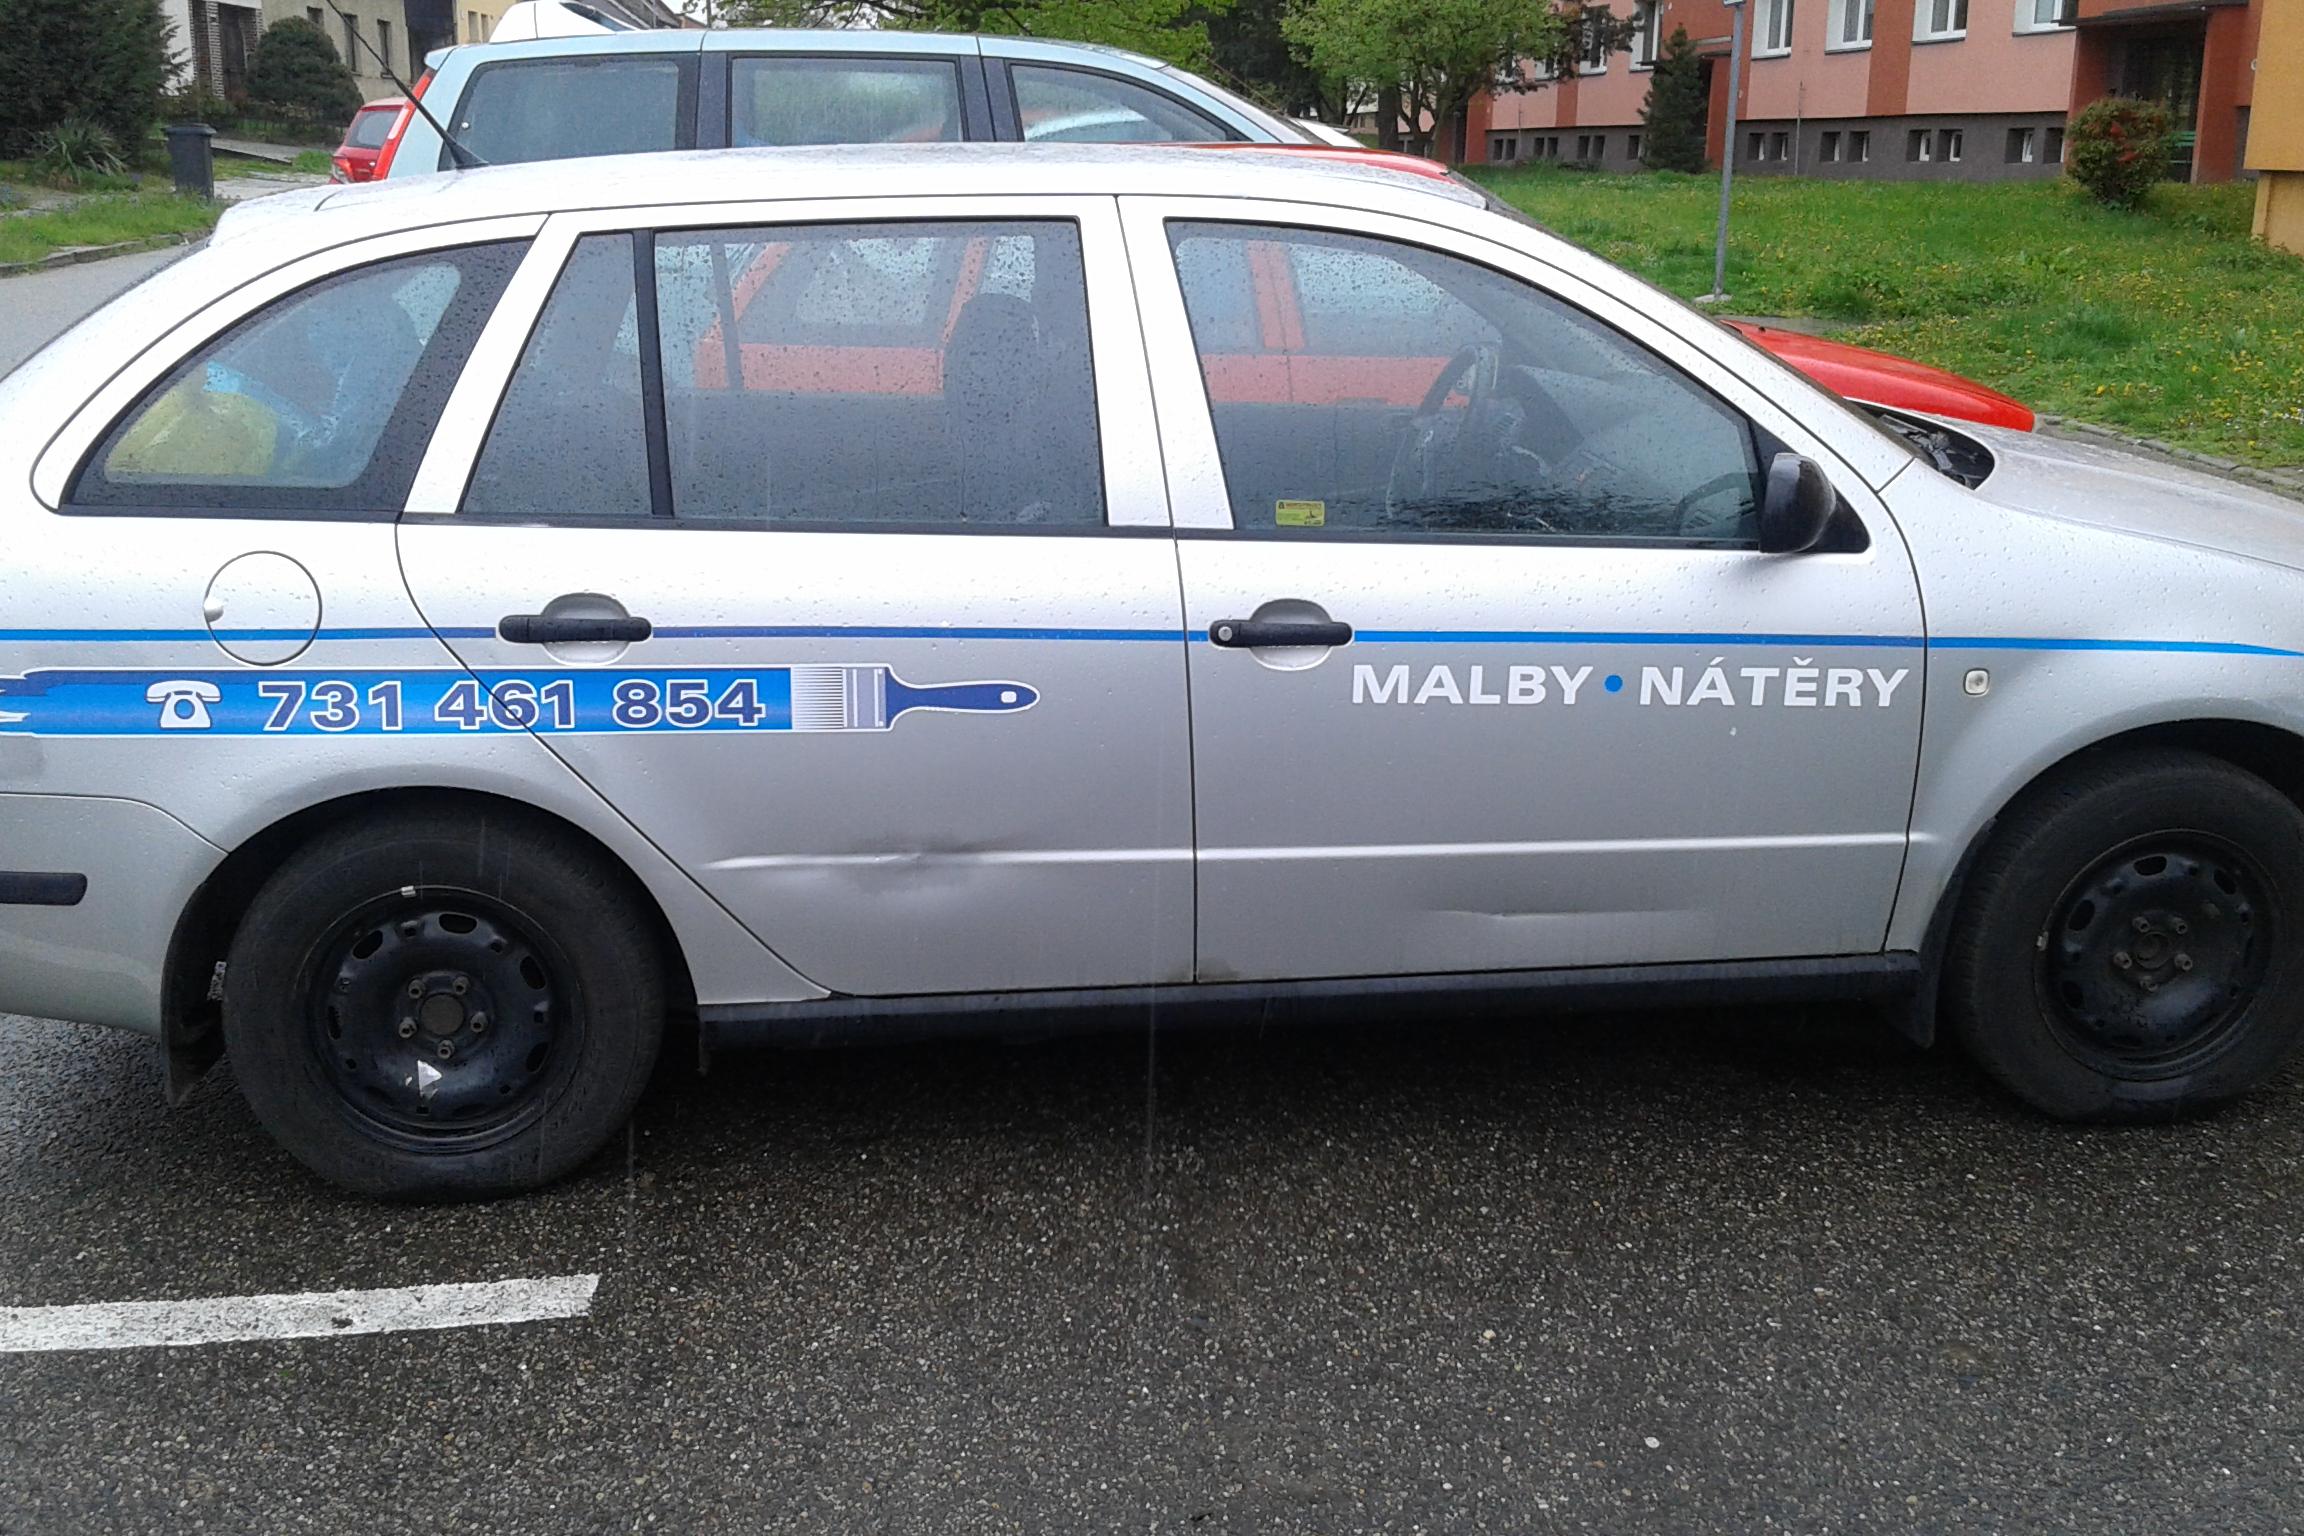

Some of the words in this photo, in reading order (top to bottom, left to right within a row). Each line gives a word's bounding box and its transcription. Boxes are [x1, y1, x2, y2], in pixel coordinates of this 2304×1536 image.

[257, 680, 402, 733] 731
[433, 680, 576, 731] 461
[611, 678, 767, 729] 854
[1351, 664, 1594, 705] MALBY
[1639, 656, 1910, 706] NÁTĚRY
